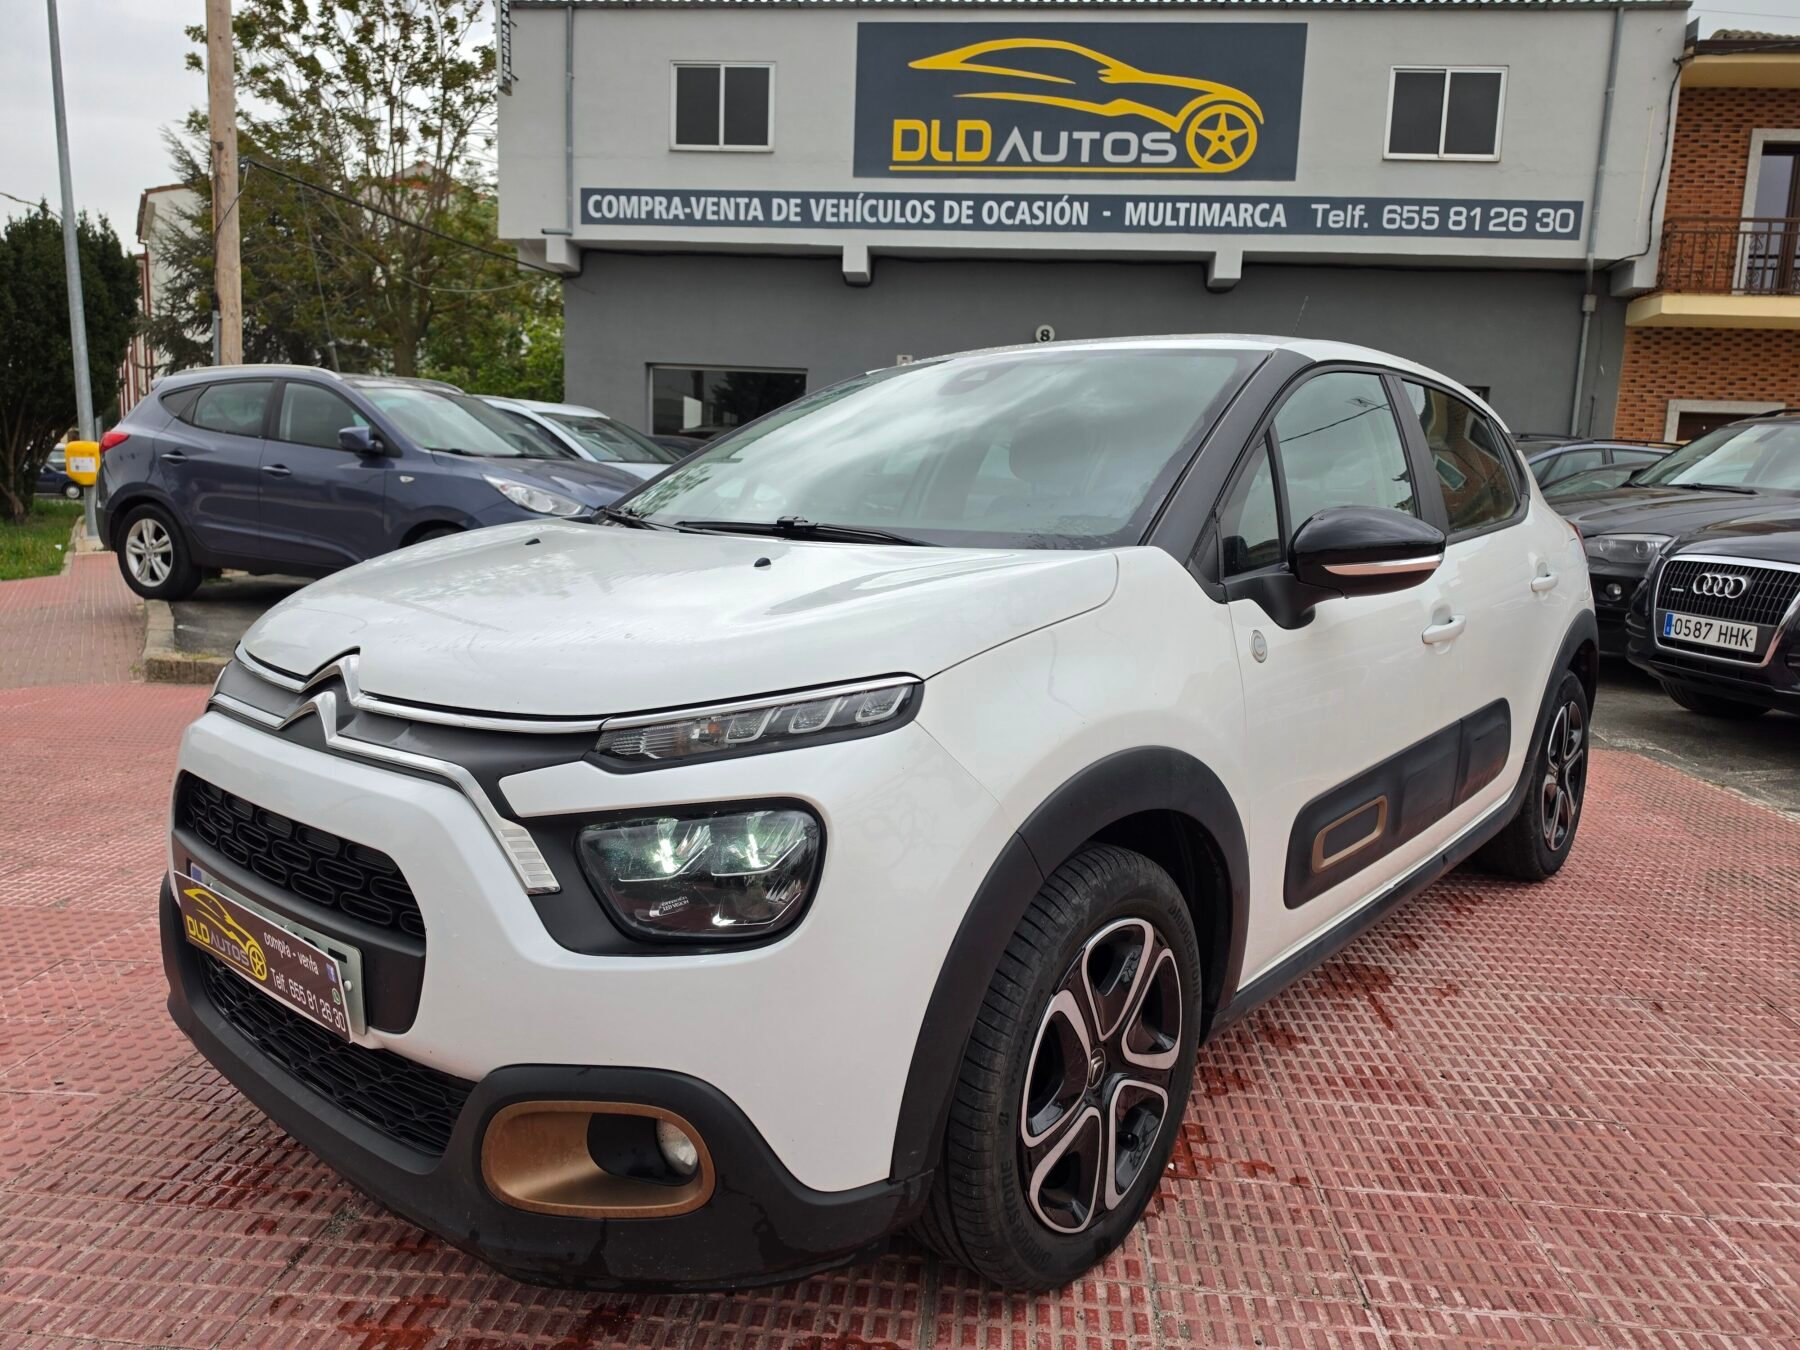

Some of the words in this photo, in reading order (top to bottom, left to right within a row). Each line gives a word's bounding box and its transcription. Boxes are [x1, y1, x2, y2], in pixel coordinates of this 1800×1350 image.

[892, 119, 992, 162] DLD
[996, 125, 1177, 163] AUTOS
[587, 194, 764, 221] COMPRA-VENTA
[771, 198, 801, 222] DE
[809, 193, 935, 224] VEHÍCULOS
[943, 200, 974, 224] DE
[981, 195, 1089, 226] OCASIÓN
[1124, 202, 1287, 228] MULTIMARCA
[1311, 203, 1369, 229] Telf.
[1382, 204, 1440, 230] 655
[1448, 206, 1482, 231] 81
[1488, 207, 1527, 232] 26
[1535, 208, 1575, 233] 30
[1040, 329, 1051, 342] 8
[1674, 618, 1713, 640] 0587
[1717, 624, 1752, 647] HHK
[186, 915, 211, 944] DLD
[210, 931, 250, 967] AUTOS
[263, 932, 292, 959] compra
[298, 951, 319, 976] venta
[270, 968, 289, 994] Telf.
[288, 979, 307, 1006] 655
[306, 990, 319, 1014] 81
[319, 998, 333, 1023] 26
[332, 1006, 347, 1032] 30
